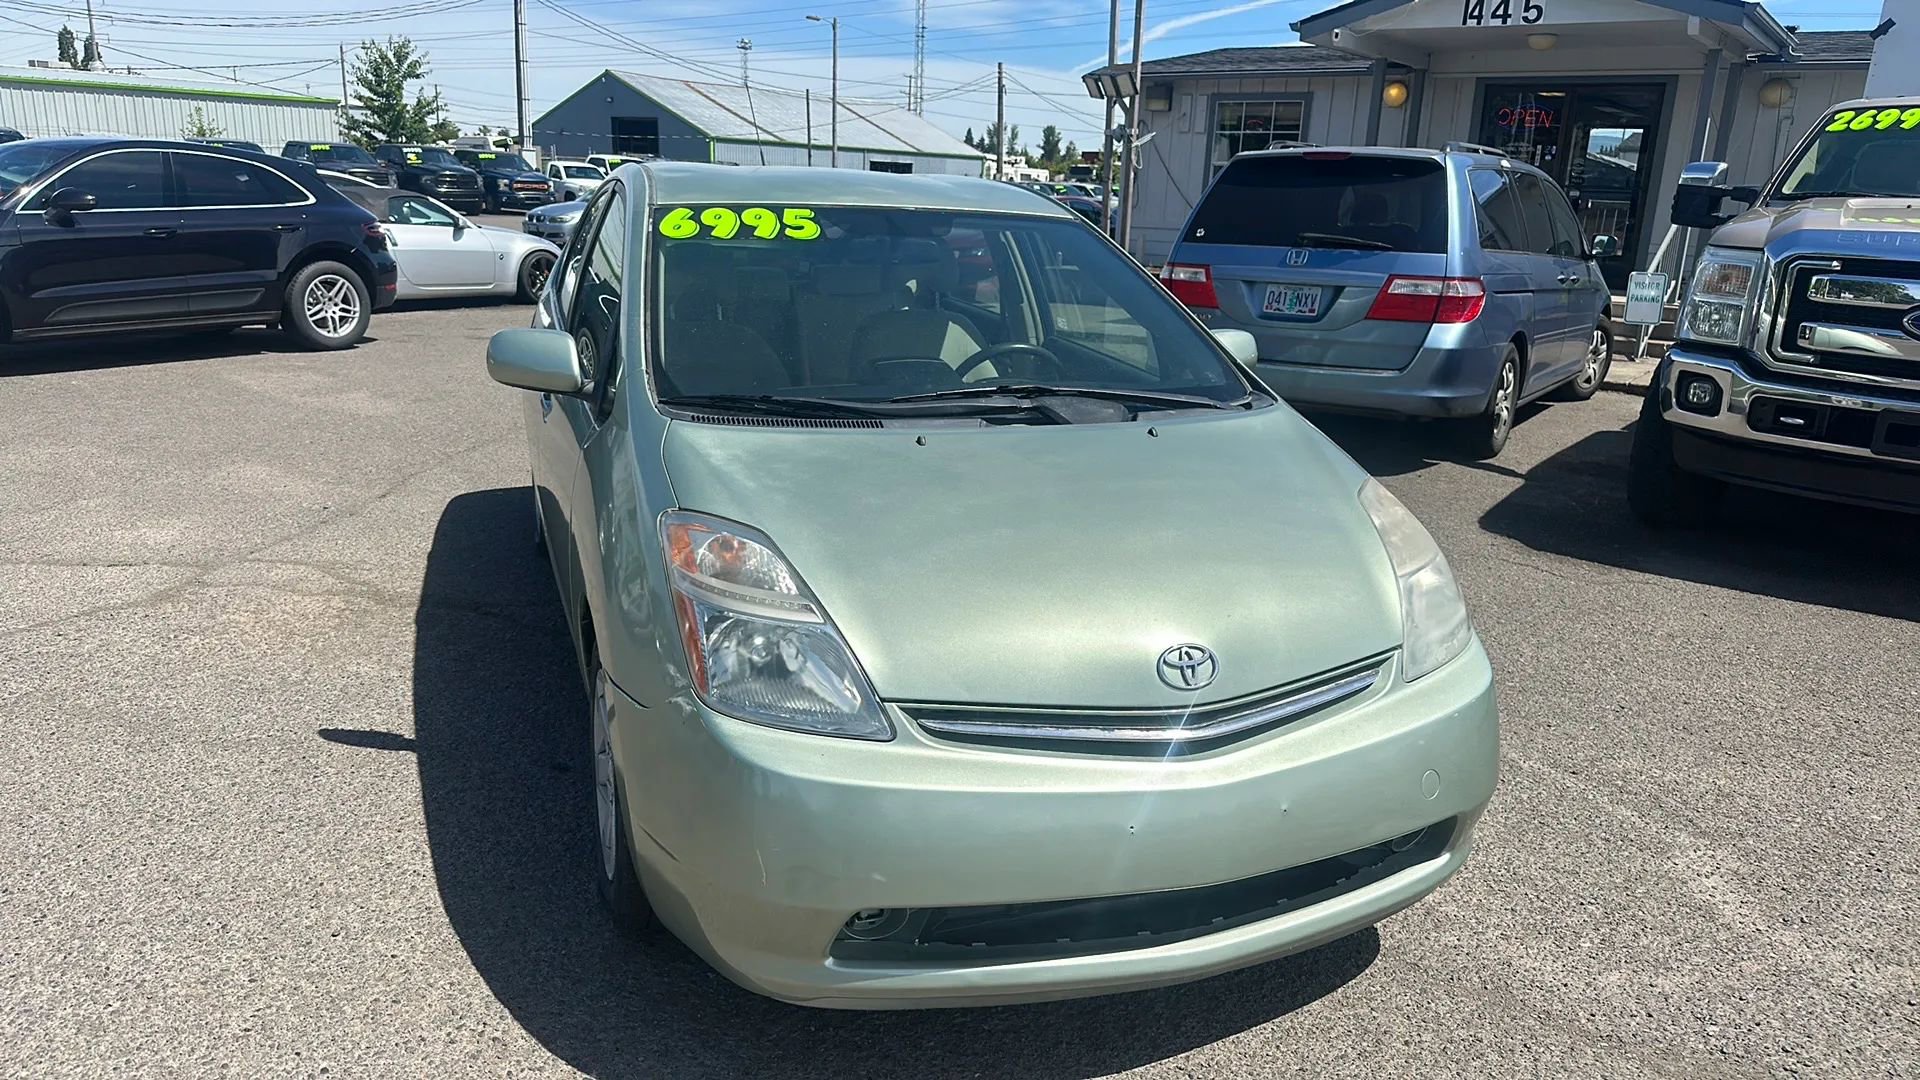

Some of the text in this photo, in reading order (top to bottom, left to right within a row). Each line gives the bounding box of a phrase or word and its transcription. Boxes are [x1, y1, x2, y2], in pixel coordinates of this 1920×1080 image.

[1462, 0, 1543, 25] 1445
[1499, 108, 1553, 128] OPEN
[1825, 108, 1920, 131] 2699
[659, 207, 821, 240] 6995
[1634, 281, 1660, 290] VISITOR
[1267, 290, 1318, 308] 041 NXV
[1630, 294, 1660, 304] PARKING
